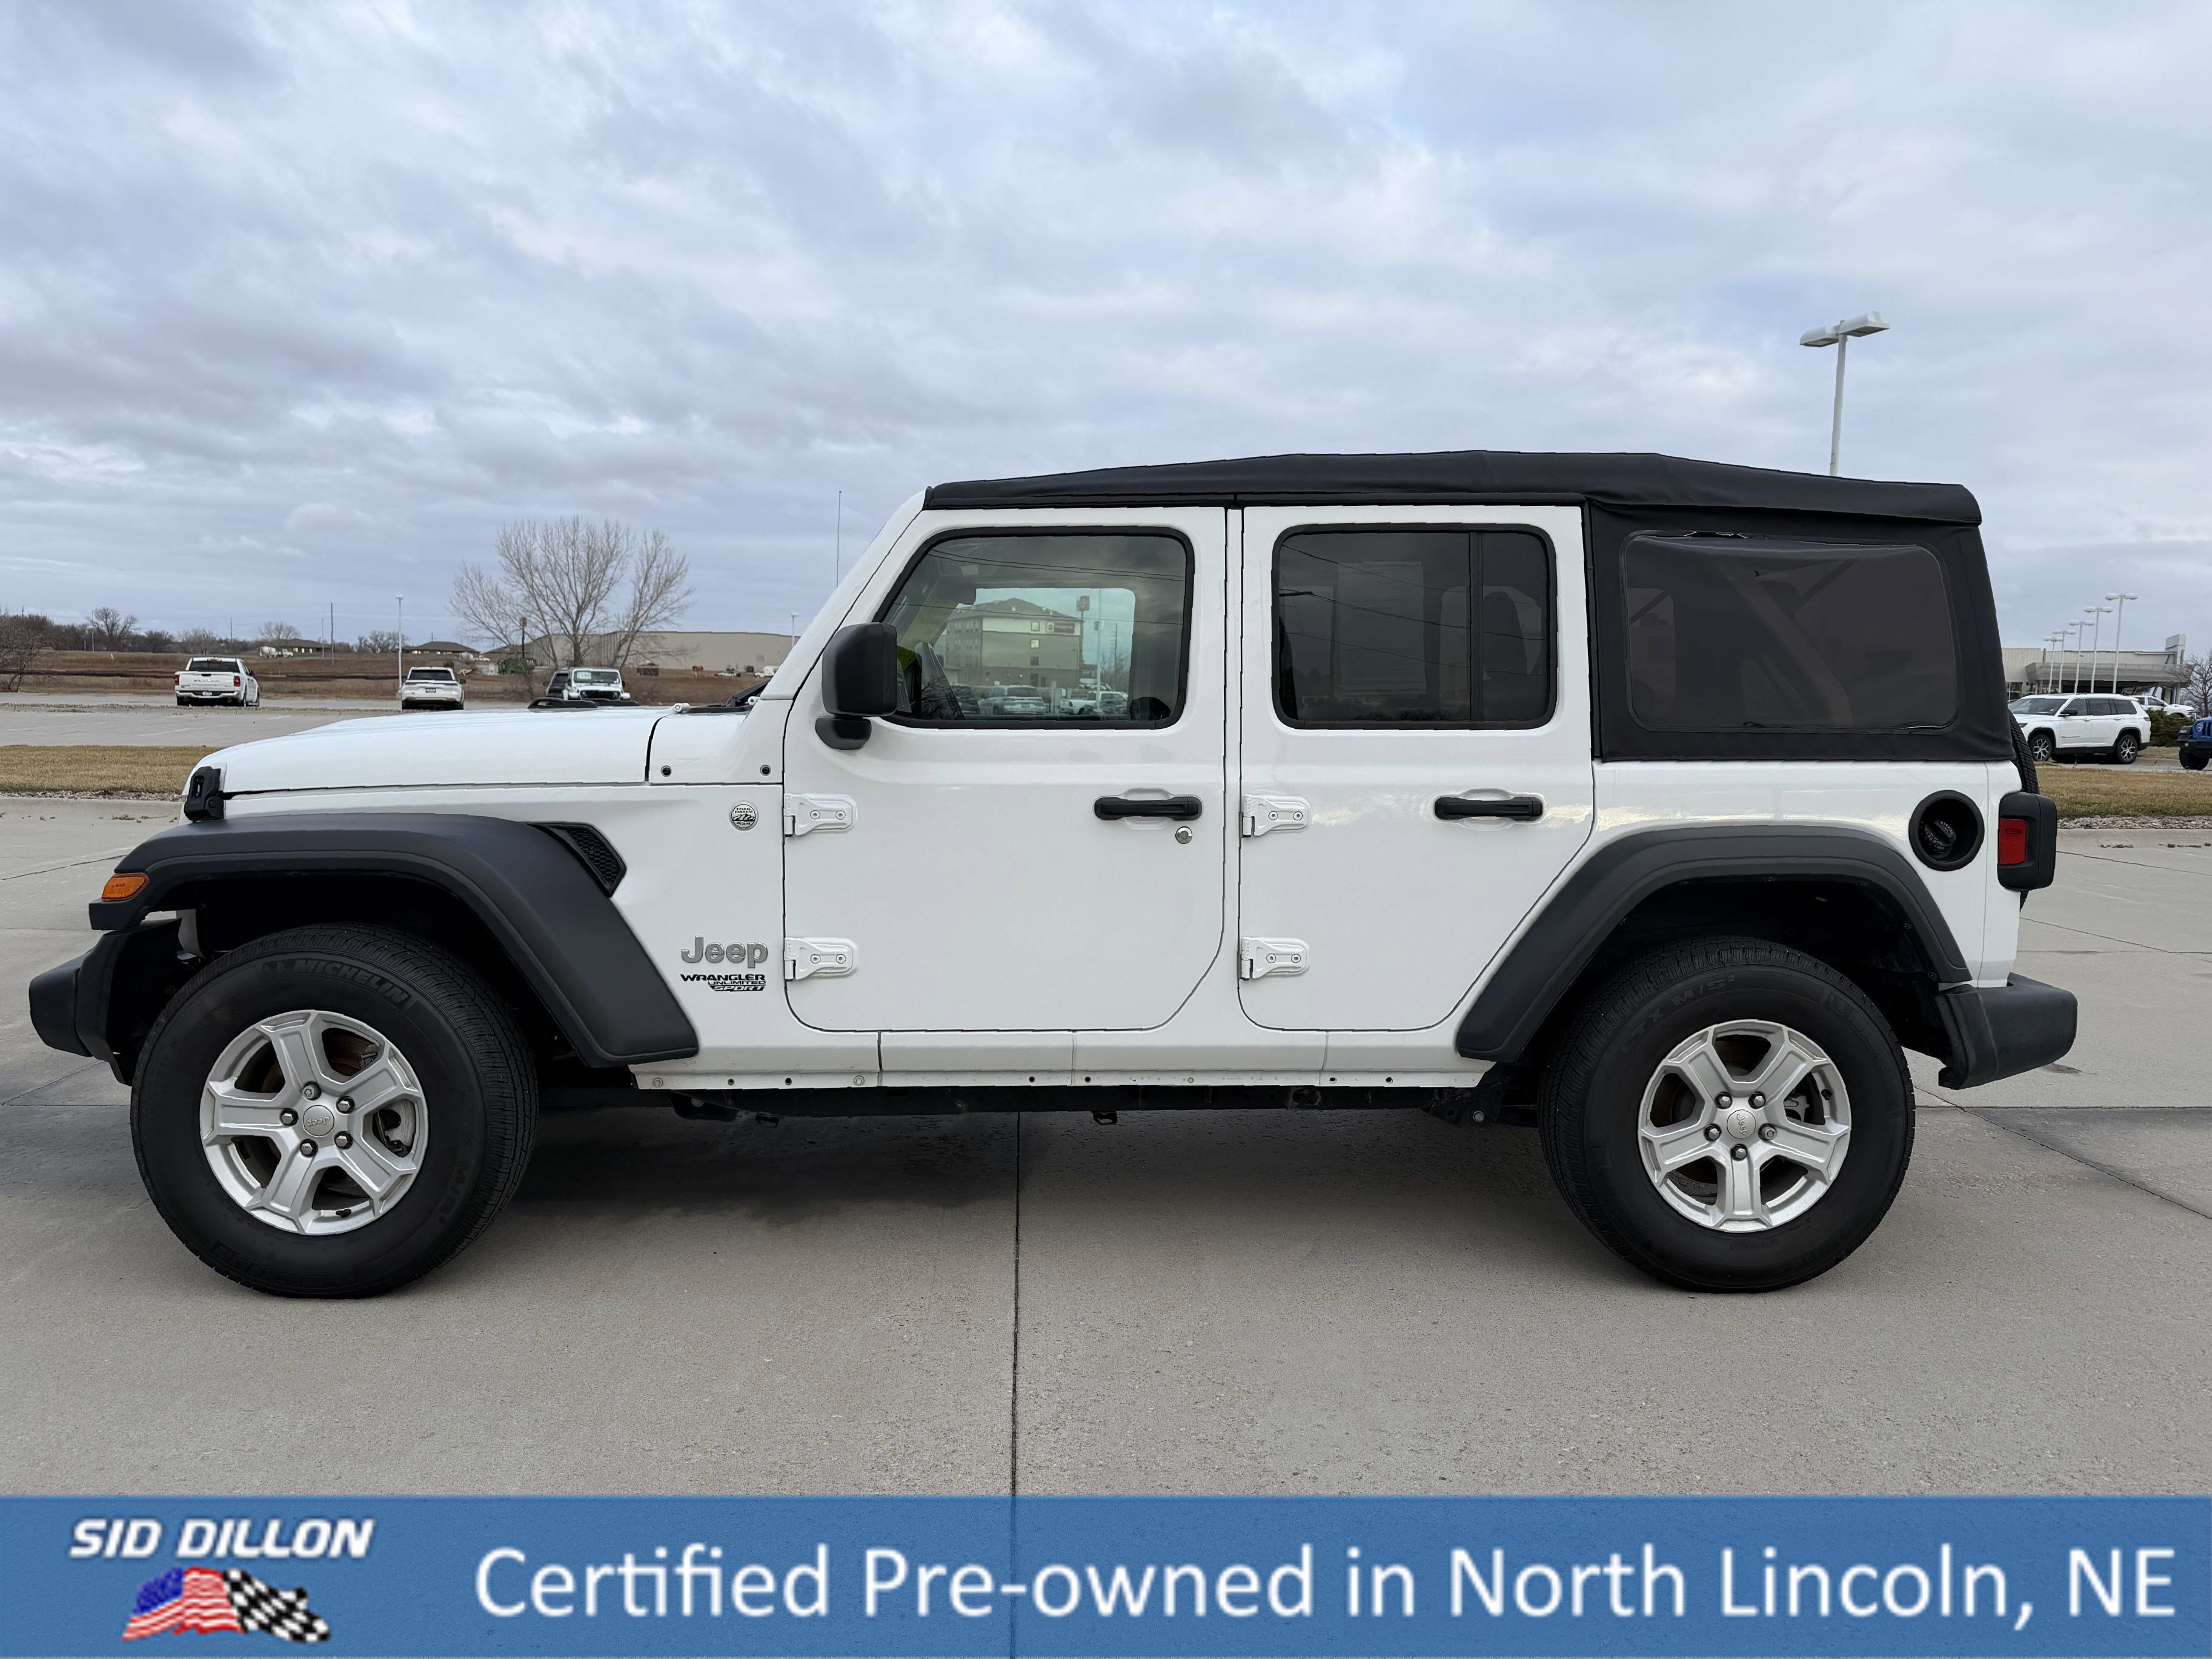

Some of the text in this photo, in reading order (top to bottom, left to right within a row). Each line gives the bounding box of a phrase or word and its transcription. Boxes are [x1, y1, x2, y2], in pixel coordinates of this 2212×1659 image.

[681, 936, 768, 968] Jeep
[293, 959, 410, 1006] MICHELIN
[680, 973, 766, 982] WRANGLER
[307, 1116, 330, 1127] Jeep
[1736, 1113, 1748, 1135] Jeep
